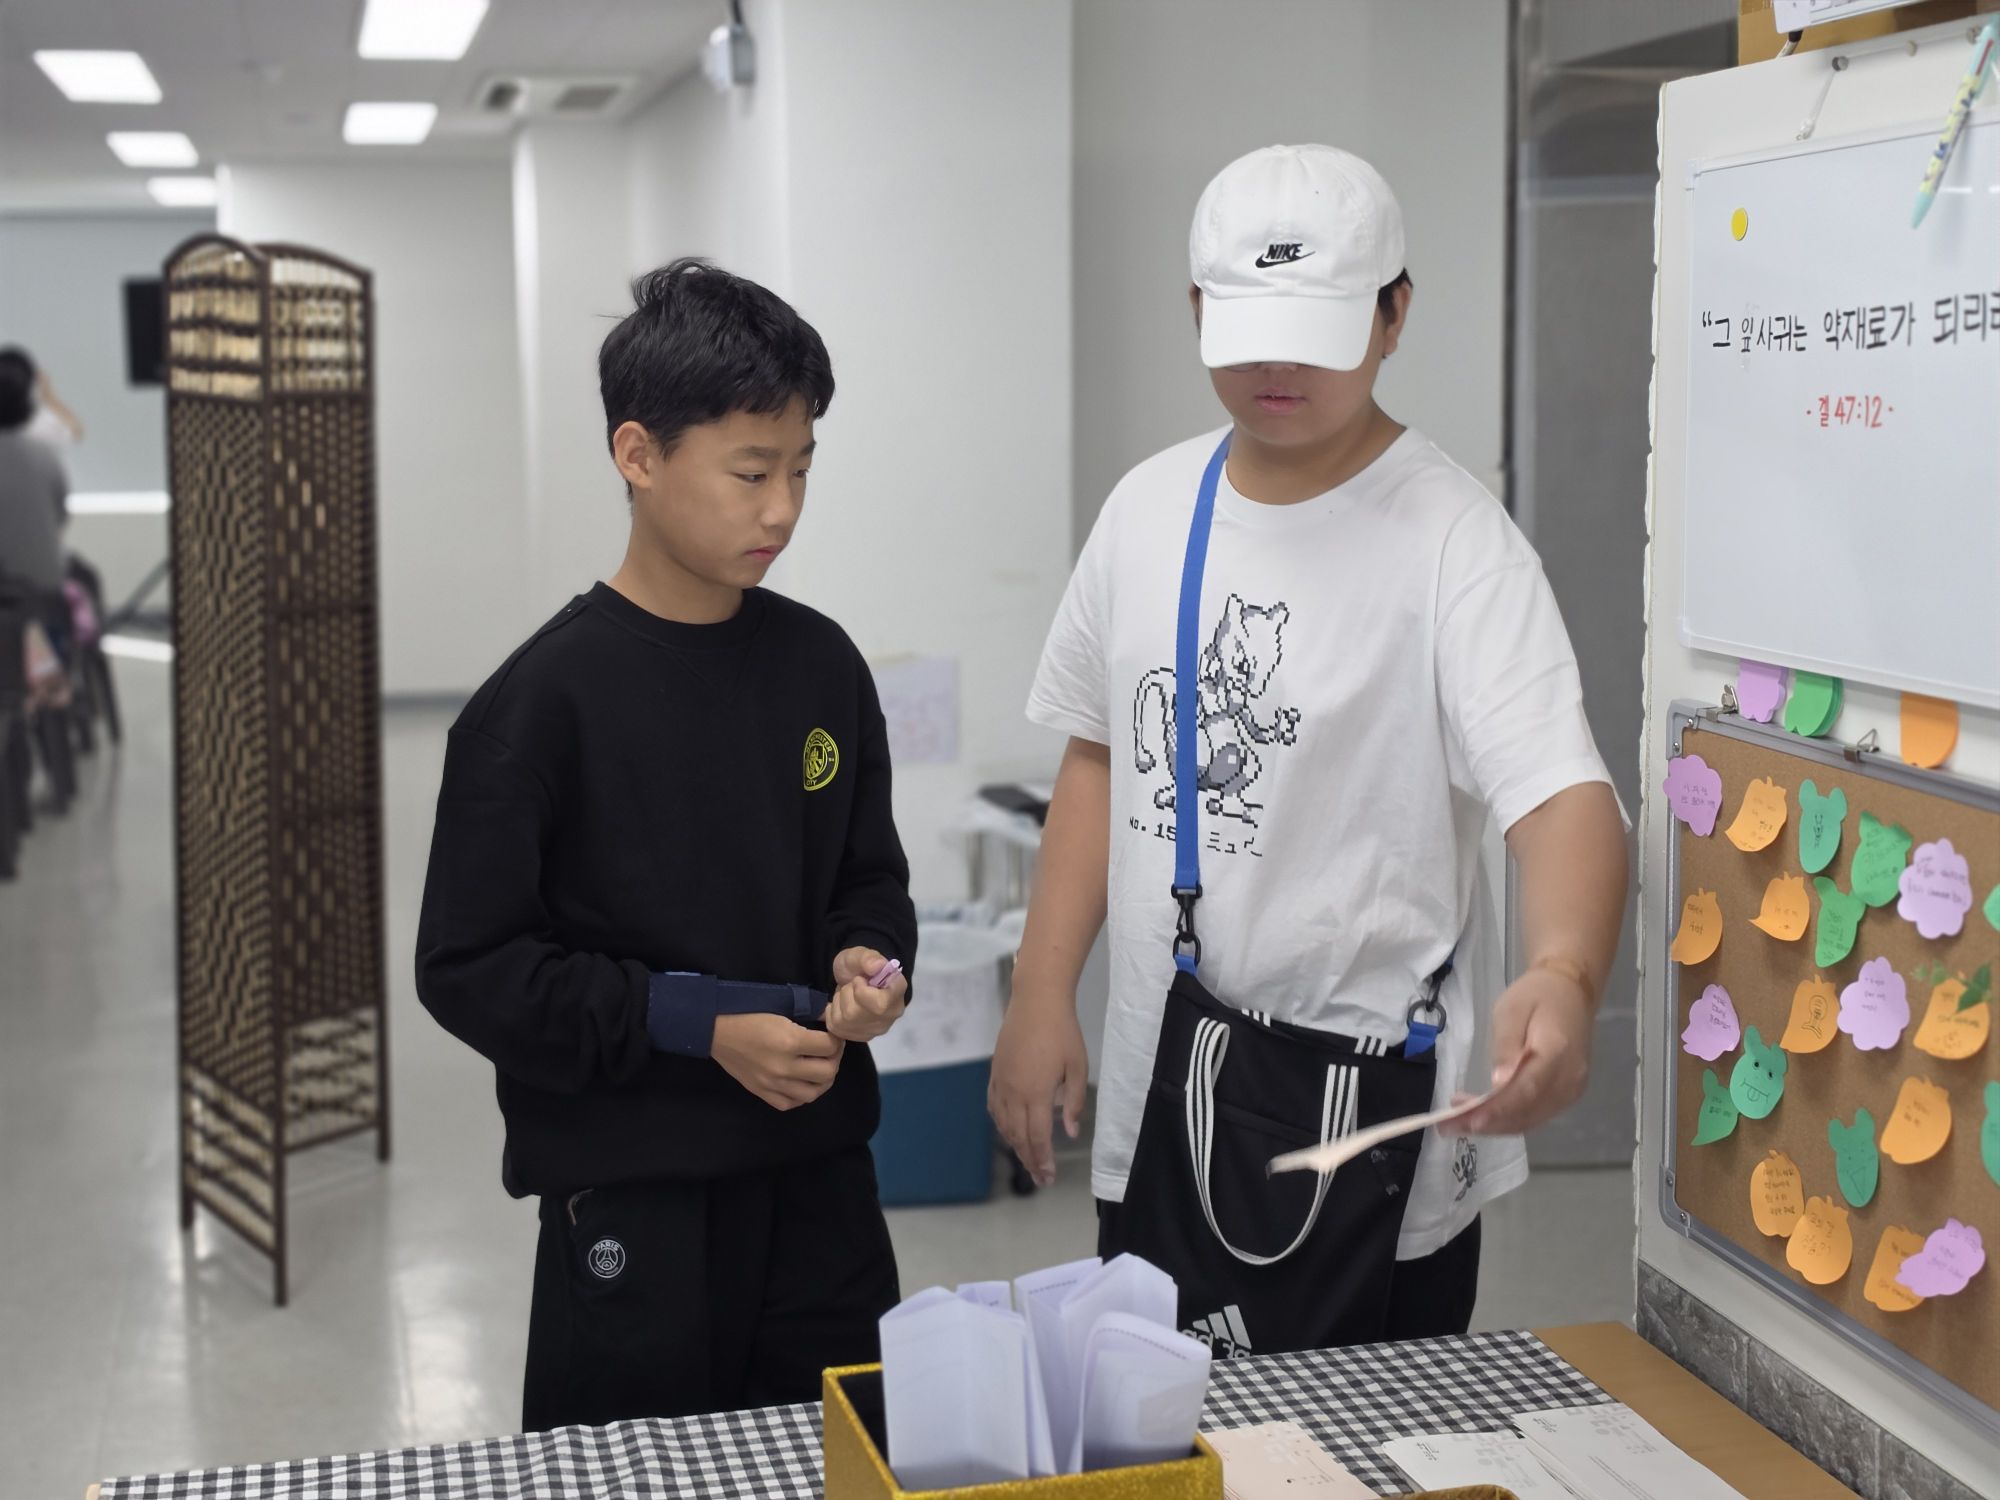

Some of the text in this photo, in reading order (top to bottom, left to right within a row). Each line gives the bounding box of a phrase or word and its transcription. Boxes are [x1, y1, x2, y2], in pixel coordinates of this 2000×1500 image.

[1265, 243, 1303, 260] NIKE
[1741, 315, 1807, 352] 잎사귀는
[1823, 301, 1916, 351] 약재료가
[1834, 395, 1883, 428] 47:12
[1153, 822, 1177, 842] 15
[594, 1241, 620, 1252] PARIS
